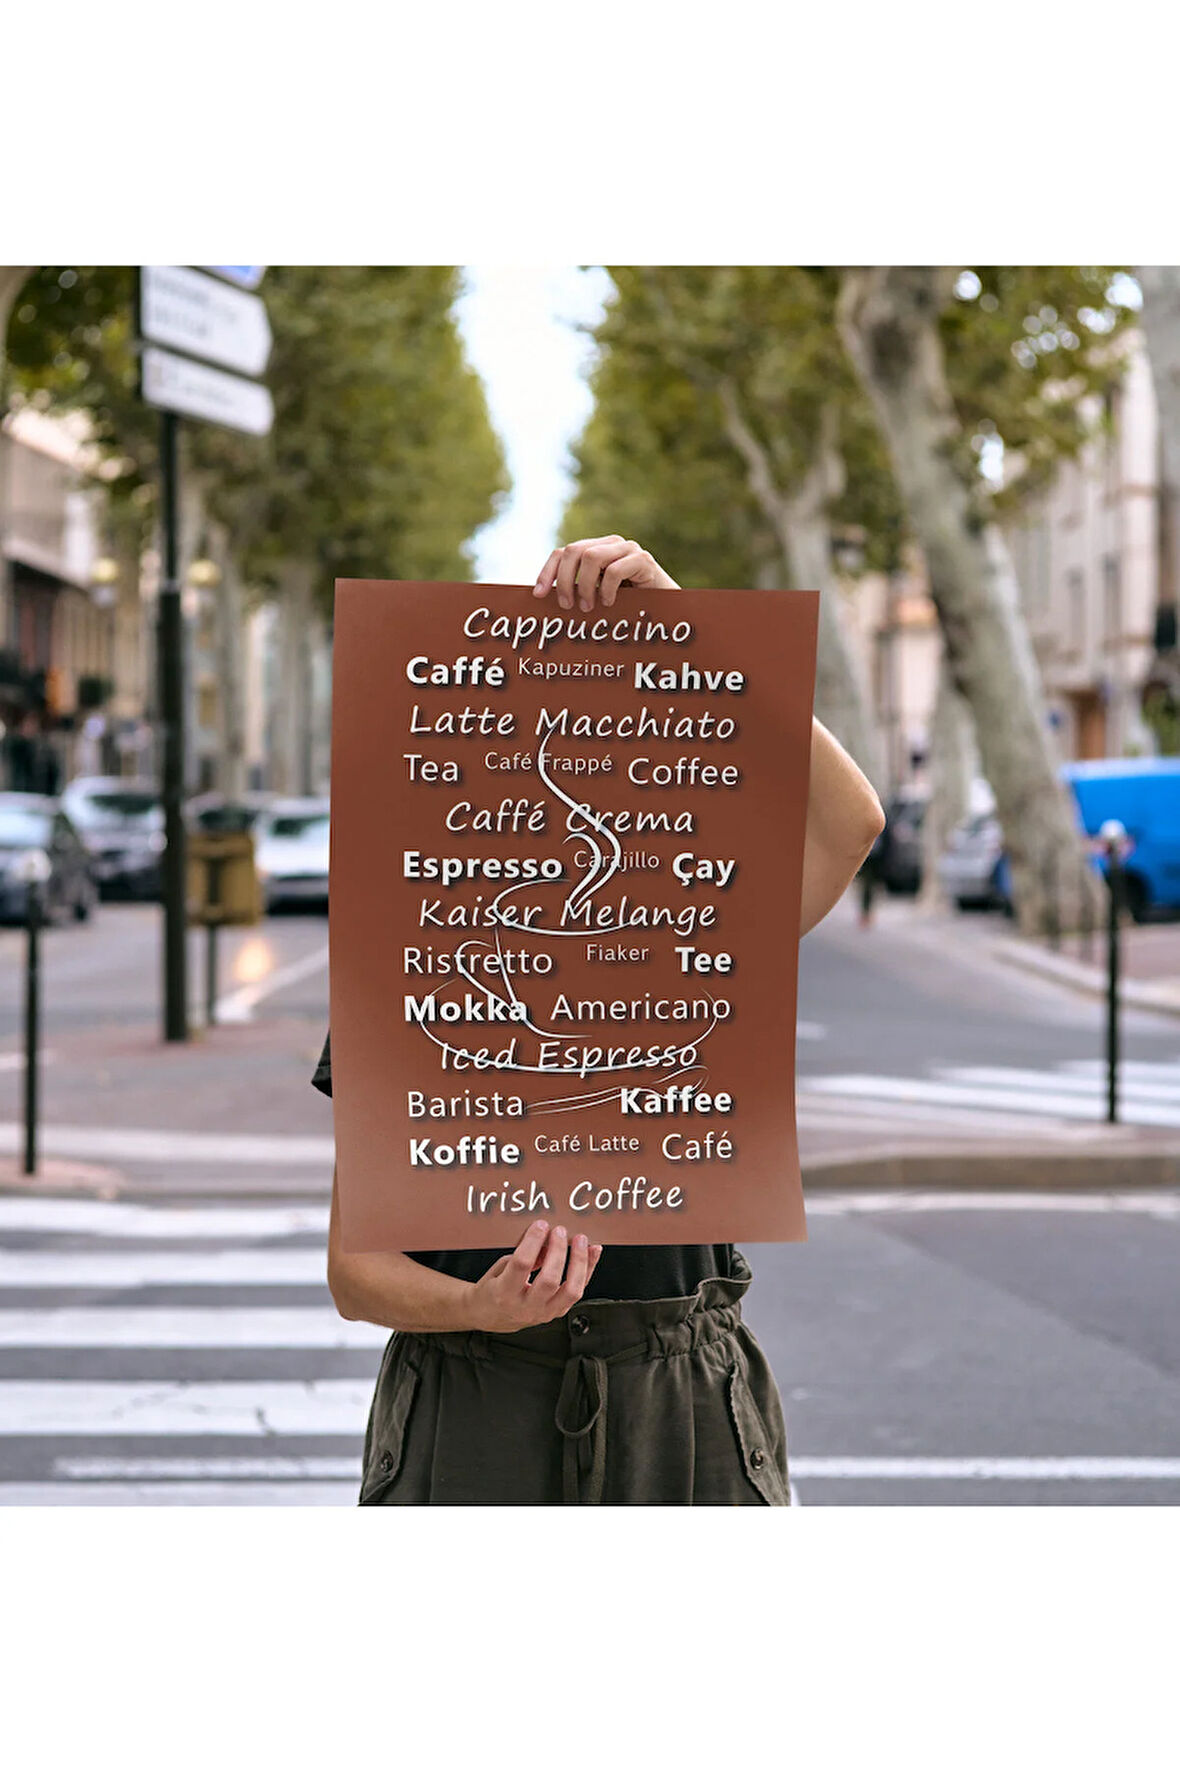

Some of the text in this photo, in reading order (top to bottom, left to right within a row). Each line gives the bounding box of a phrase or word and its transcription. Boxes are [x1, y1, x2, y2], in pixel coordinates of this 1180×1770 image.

[463, 607, 692, 650] Cappuccino
[406, 654, 744, 692] Caffé Kapuziner Kahve
[409, 706, 735, 739] Latte Macchiato
[403, 752, 738, 786] Tea Café Frappé Coffee
[445, 800, 693, 833] Caffé Crema
[403, 851, 562, 885] Espresso
[672, 853, 735, 886] Çay
[419, 895, 716, 937] Kaiser Melange
[404, 944, 732, 975] Ristretto Fiaker Tee
[404, 994, 729, 1022] Mokka Americano
[441, 1039, 697, 1079] Iced Espresso
[408, 1086, 732, 1118] Barista Kaffee
[409, 1132, 732, 1166] Koffie Café Latte Café
[466, 1177, 683, 1213] Irish Coffee
